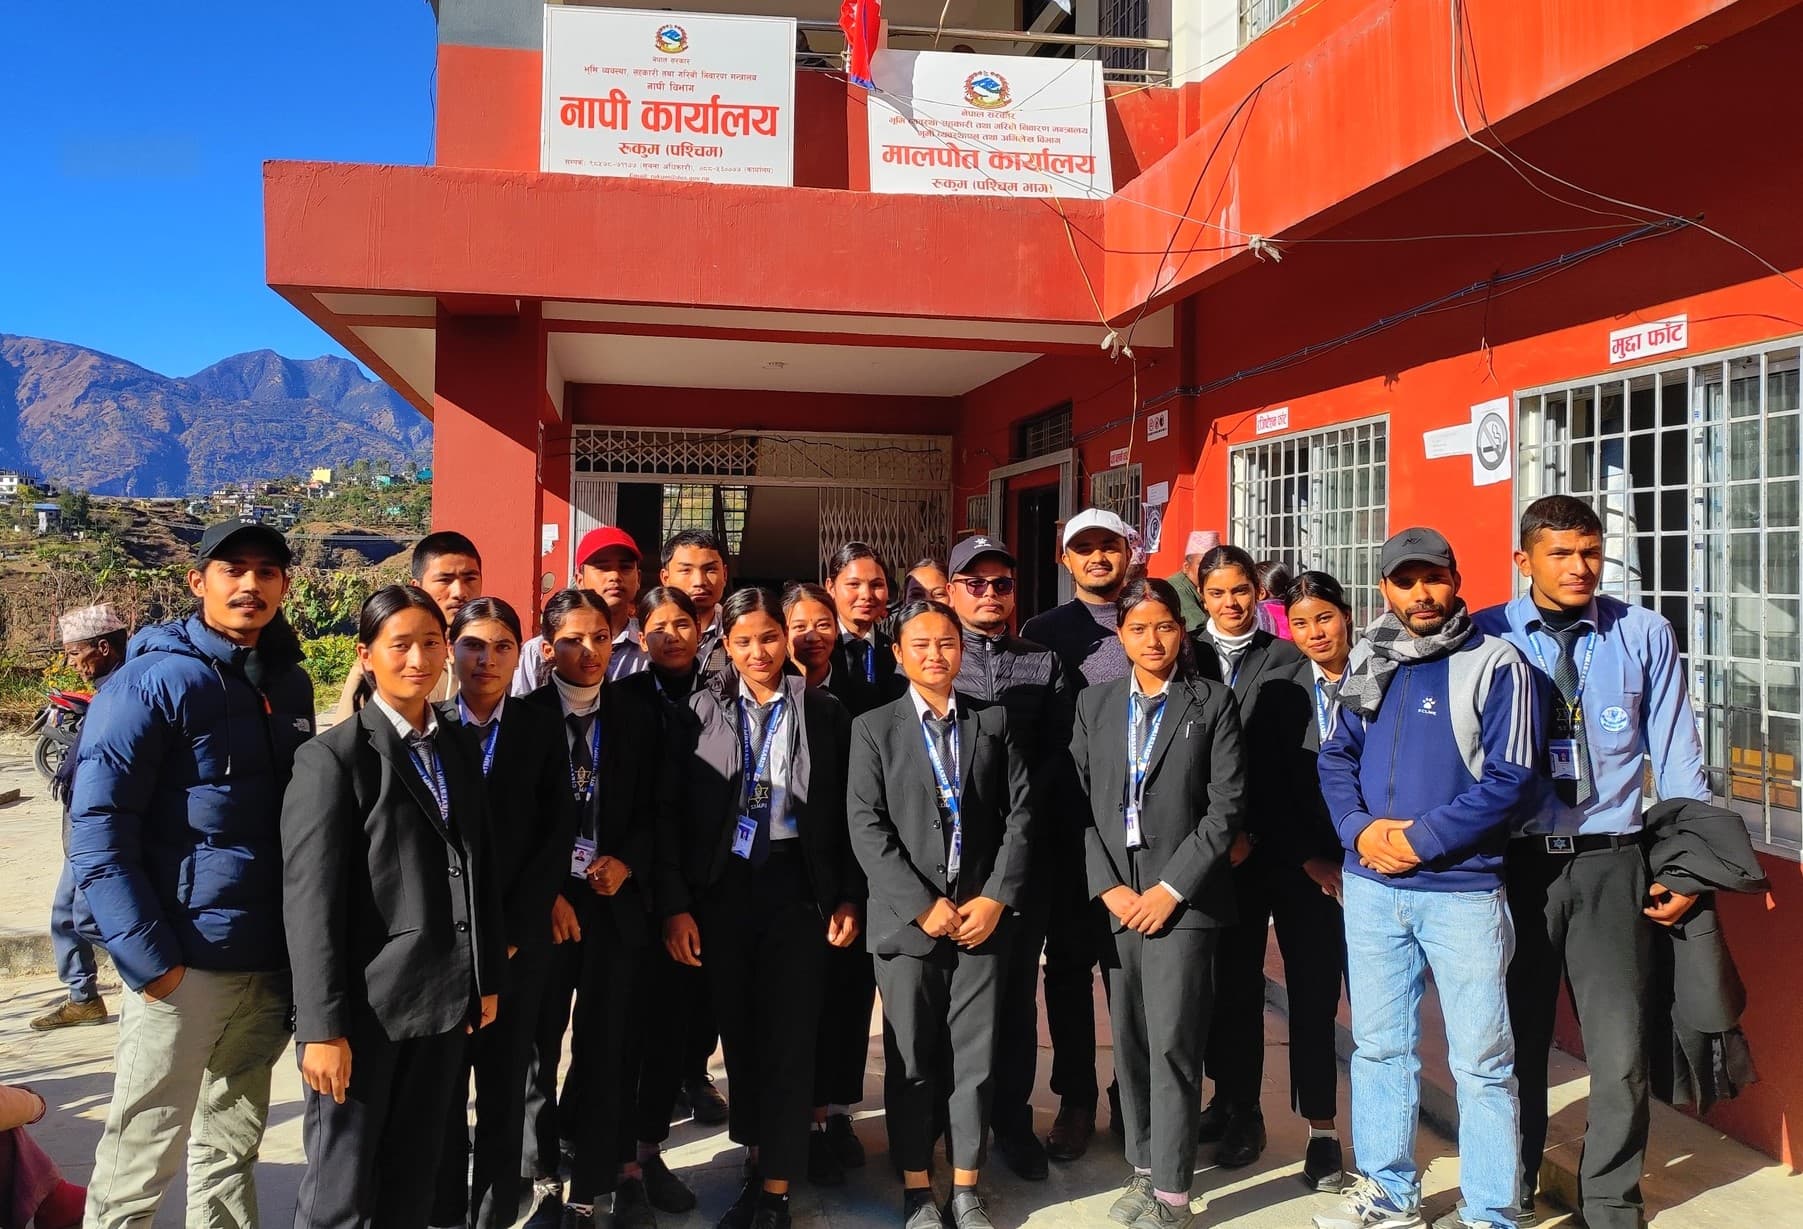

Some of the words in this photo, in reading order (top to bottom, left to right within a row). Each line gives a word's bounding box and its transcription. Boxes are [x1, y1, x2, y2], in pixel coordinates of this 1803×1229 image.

[647, 80, 665, 91] नापी
[670, 81, 695, 92] विभाग
[559, 88, 631, 131] नापी
[641, 94, 780, 137] कार्यालय
[961, 108, 984, 118] नेपाल
[618, 142, 660, 158] रुकुम
[666, 141, 723, 158] (पश्चिम)
[882, 142, 980, 169] मालपोत
[988, 148, 1097, 174] कार्यालय
[932, 178, 968, 191] रुकुम
